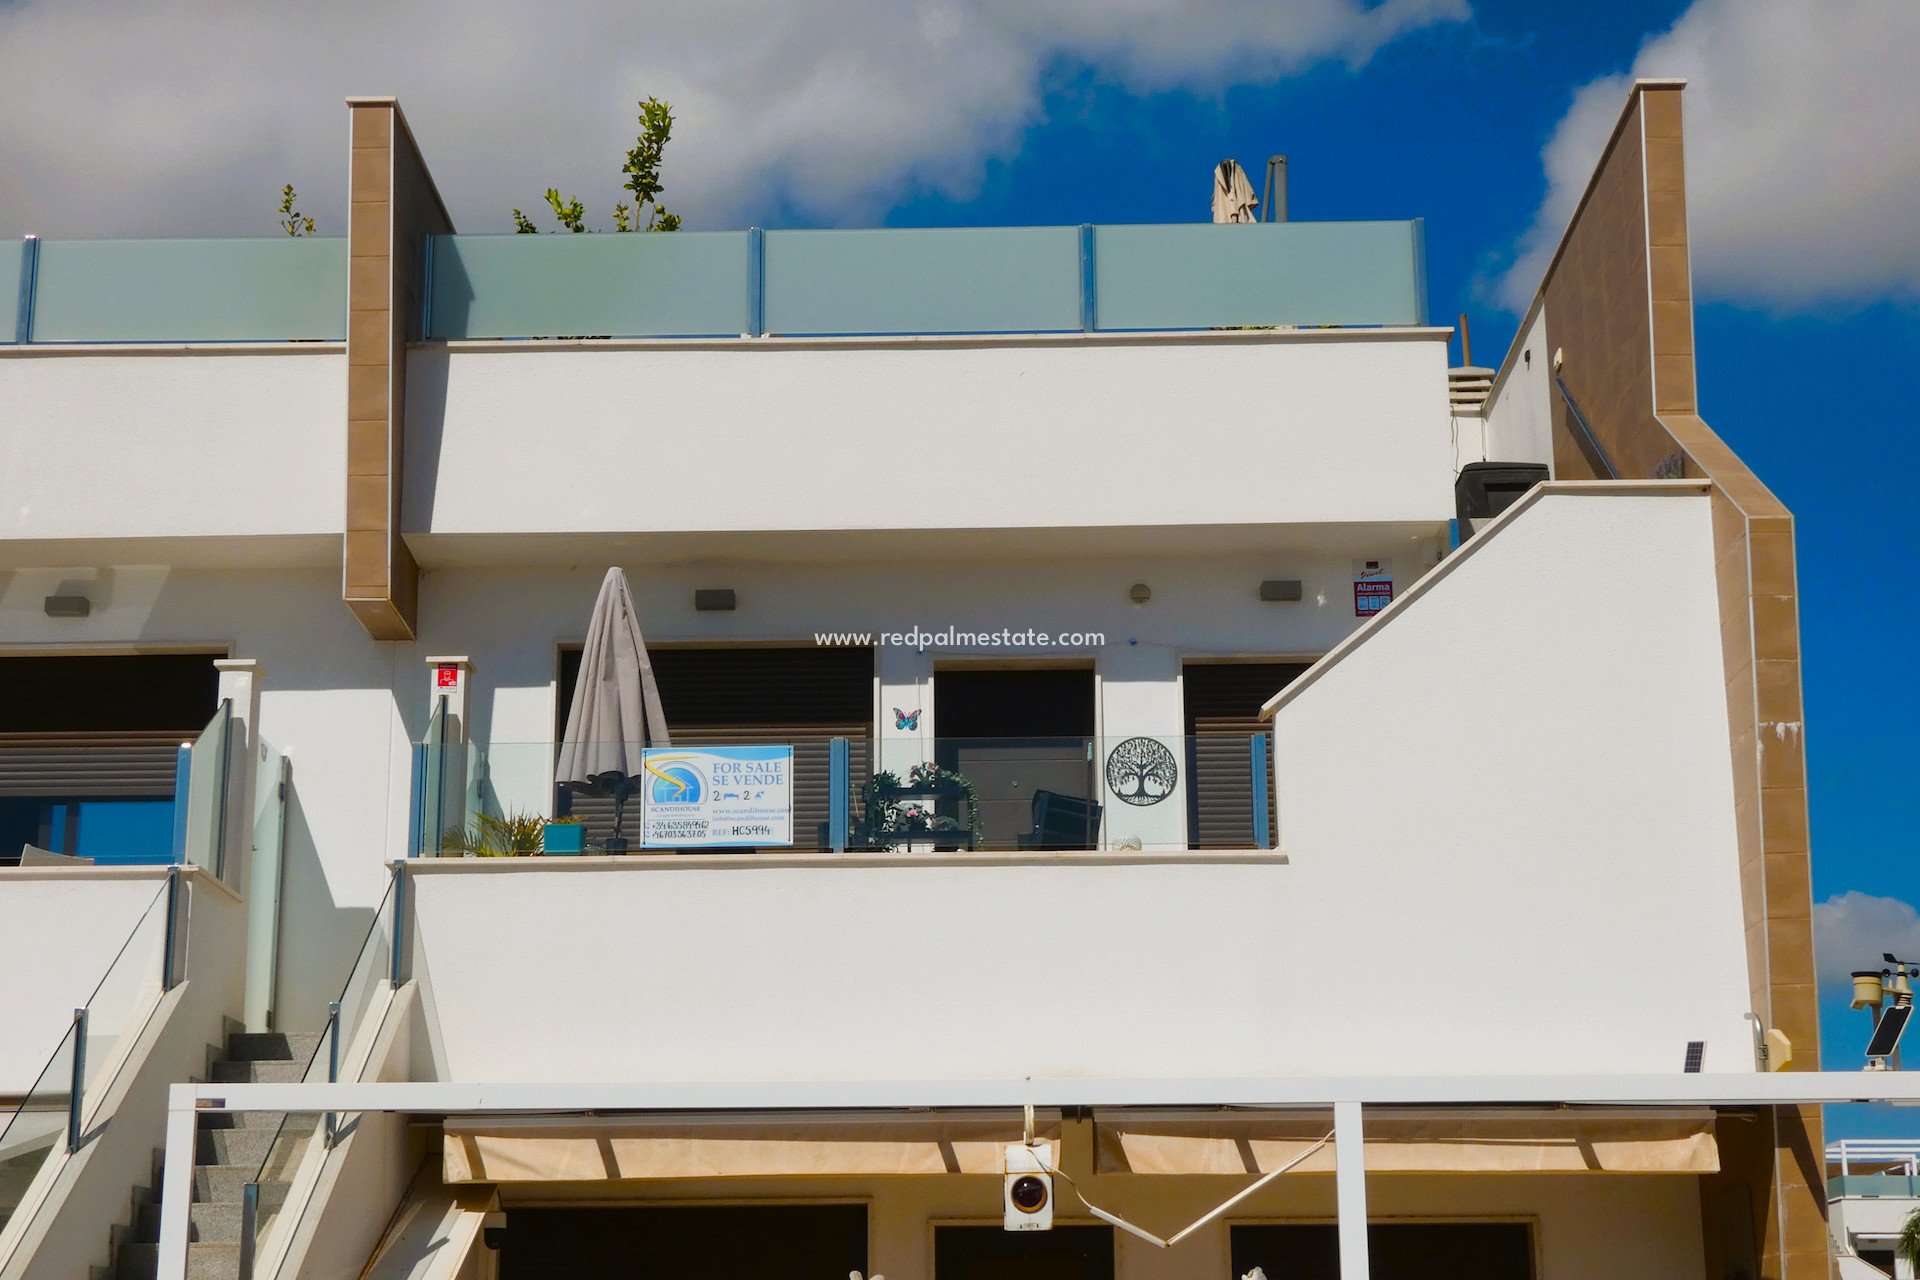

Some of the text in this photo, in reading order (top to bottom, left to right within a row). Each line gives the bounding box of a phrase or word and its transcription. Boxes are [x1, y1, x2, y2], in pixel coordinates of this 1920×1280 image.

[1357, 583, 1390, 591] Alarma
[713, 762, 782, 773] FOR SALE
[712, 774, 784, 786] SE VENDE
[713, 790, 750, 801] 2 2
[650, 805, 700, 813] SCANDIHOUSE
[712, 825, 770, 836] REF: HC5994
